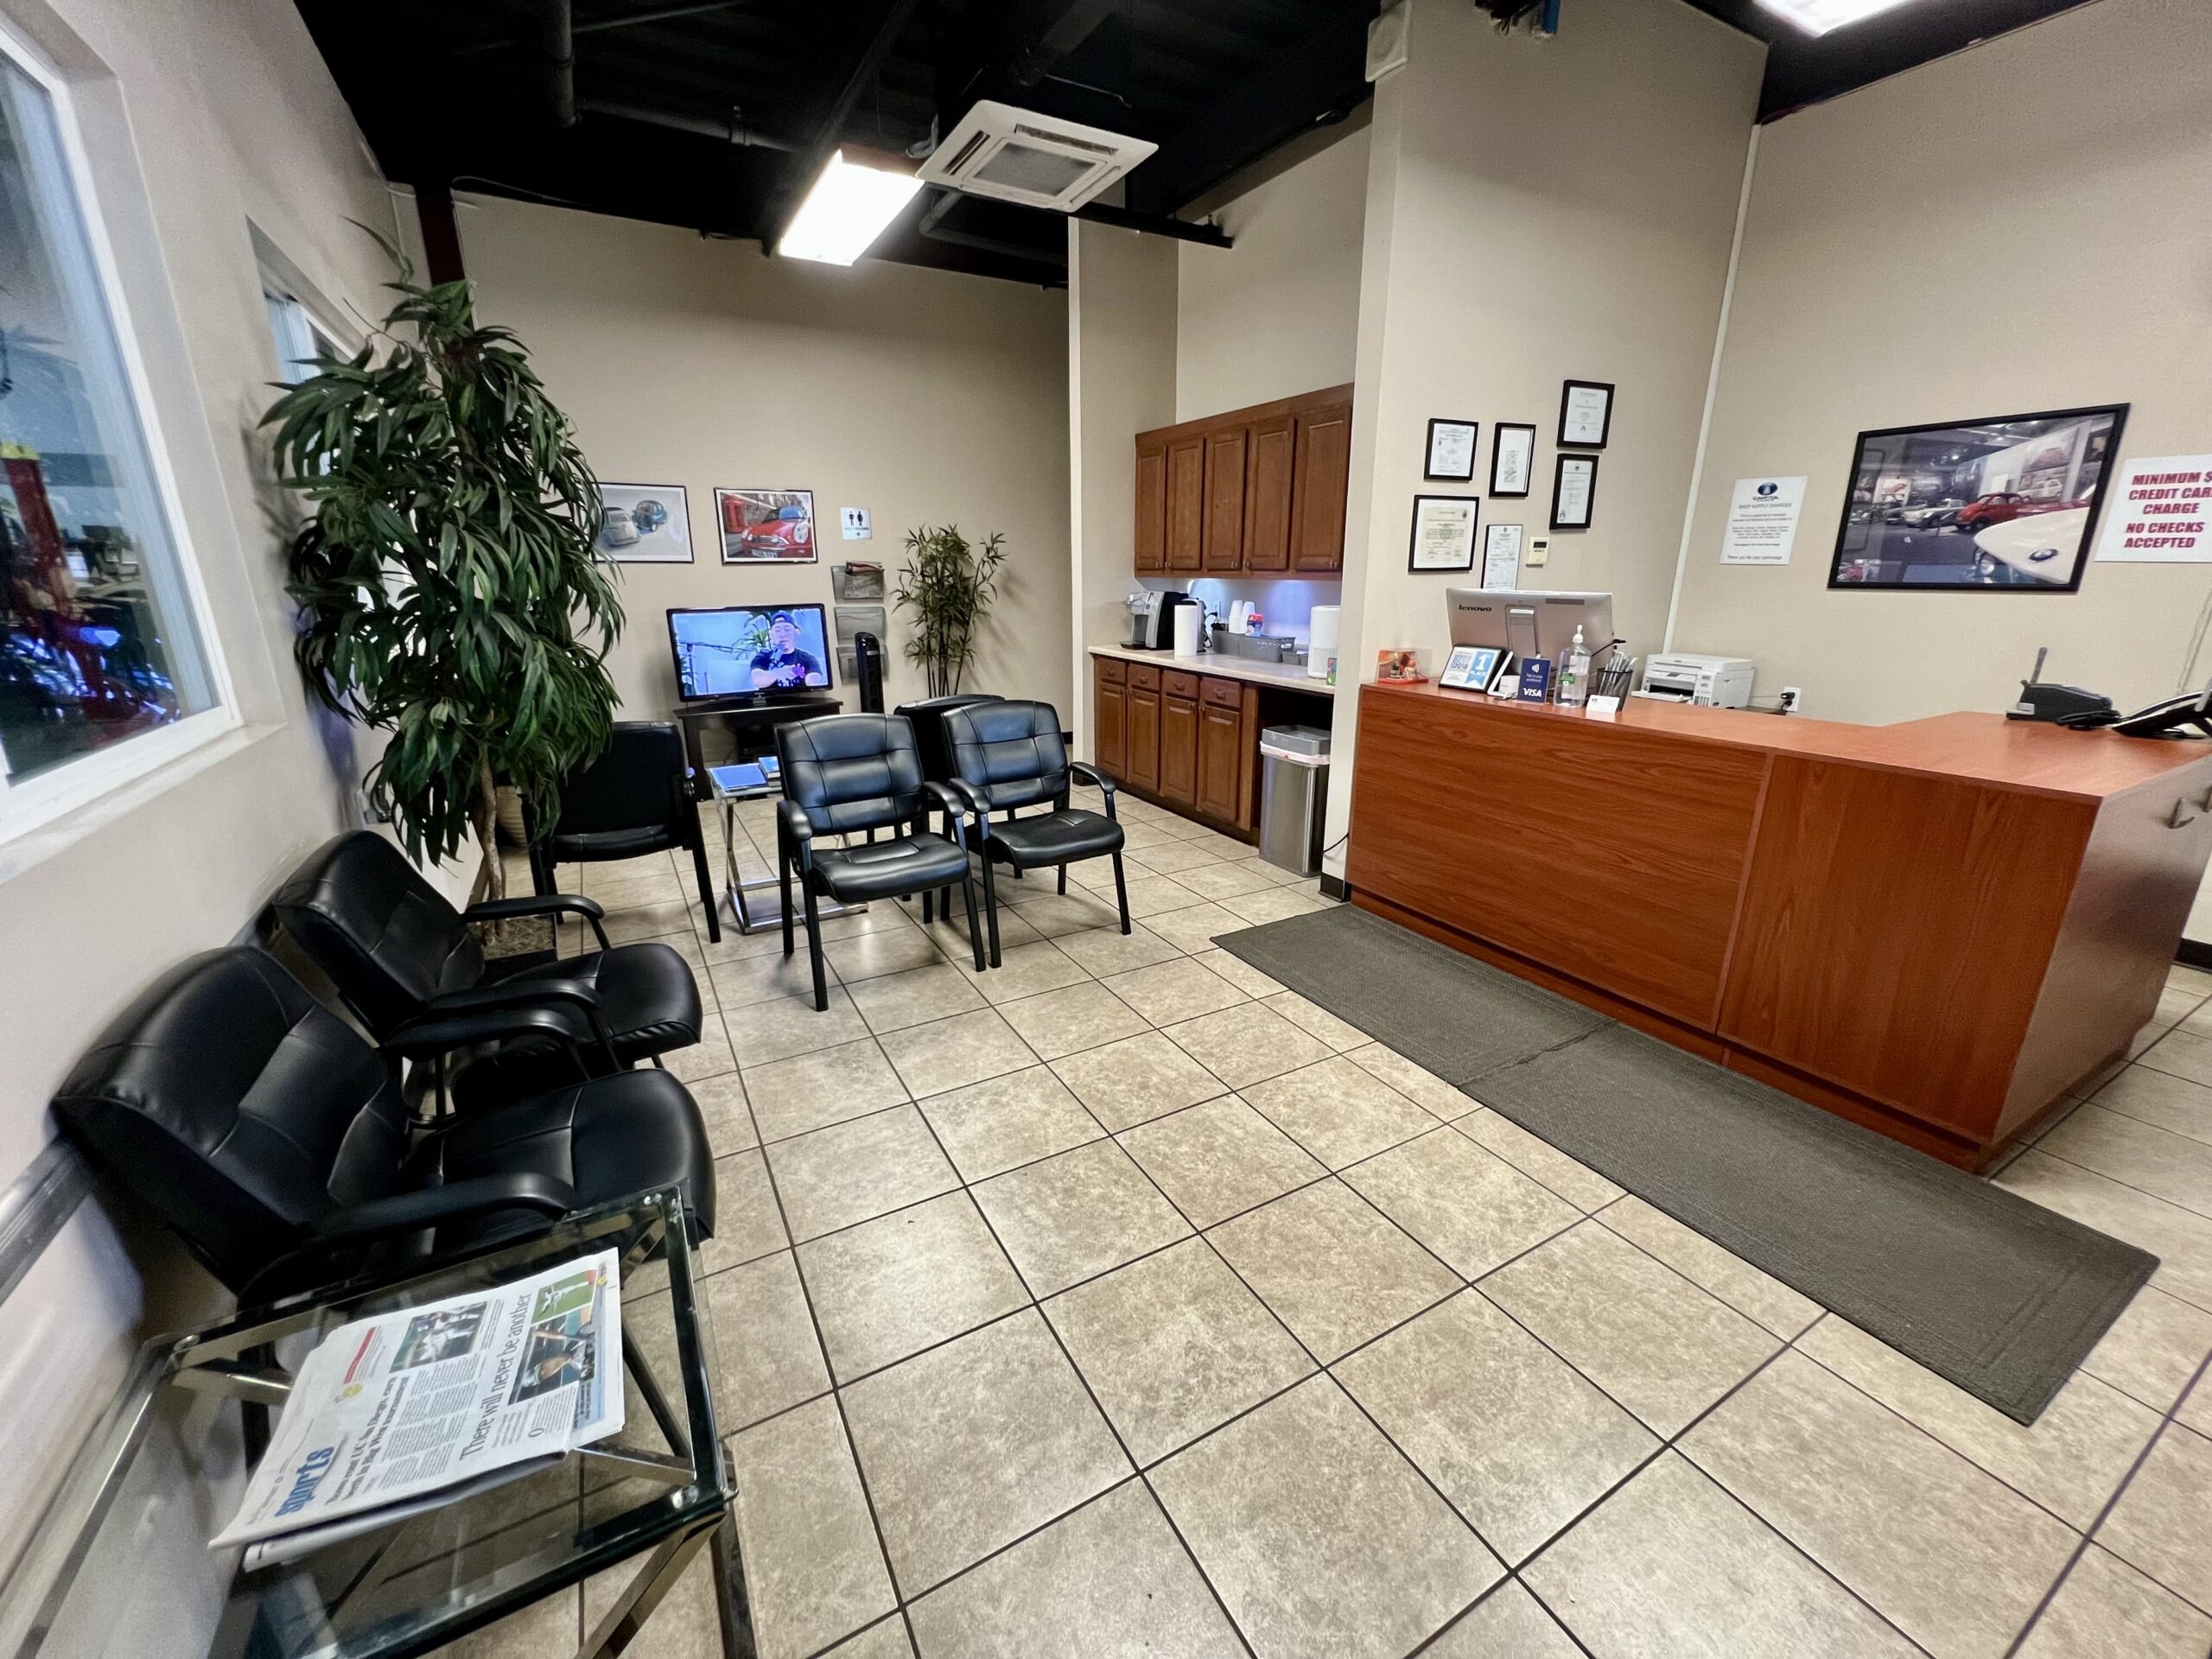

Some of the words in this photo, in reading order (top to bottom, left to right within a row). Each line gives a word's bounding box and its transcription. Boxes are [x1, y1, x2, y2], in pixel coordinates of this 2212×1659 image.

[2132, 472, 2201, 485] MINIMUM
[2128, 488, 2179, 499] CREDIT
[2182, 487, 2212, 498] CAR
[2143, 503, 2200, 514] CHARGE
[2126, 523, 2145, 533] NO
[2147, 522, 2205, 533] CHECKS
[2124, 537, 2196, 548] ACCEPTED
[1522, 688, 1542, 697] VISA
[507, 1293, 531, 1338] another
[496, 1338, 518, 1357] be
[489, 1357, 514, 1392] never
[480, 1393, 503, 1418] will
[458, 1418, 493, 1460] There
[272, 1446, 335, 1516] sports
